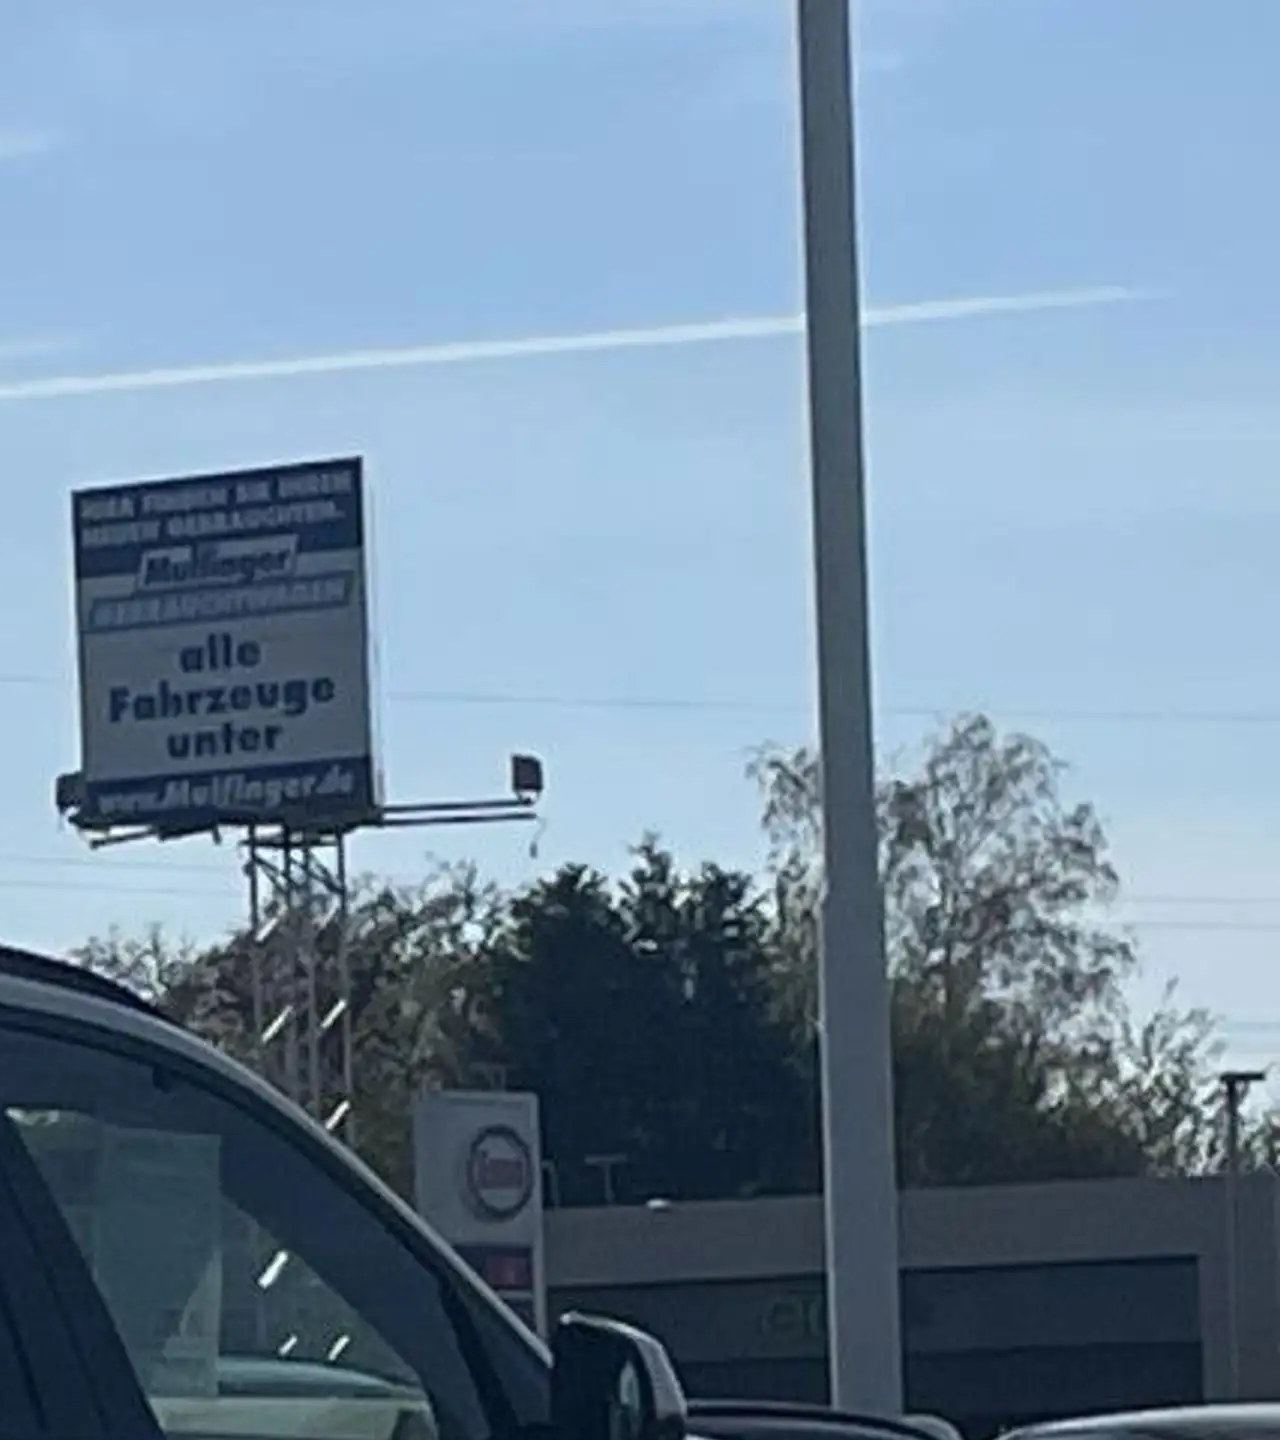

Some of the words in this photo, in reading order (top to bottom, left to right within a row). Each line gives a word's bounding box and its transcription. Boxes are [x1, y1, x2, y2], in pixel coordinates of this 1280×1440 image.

[179, 632, 262, 674] alle
[108, 676, 336, 722] Fahrzeuge
[166, 720, 284, 759] unter
